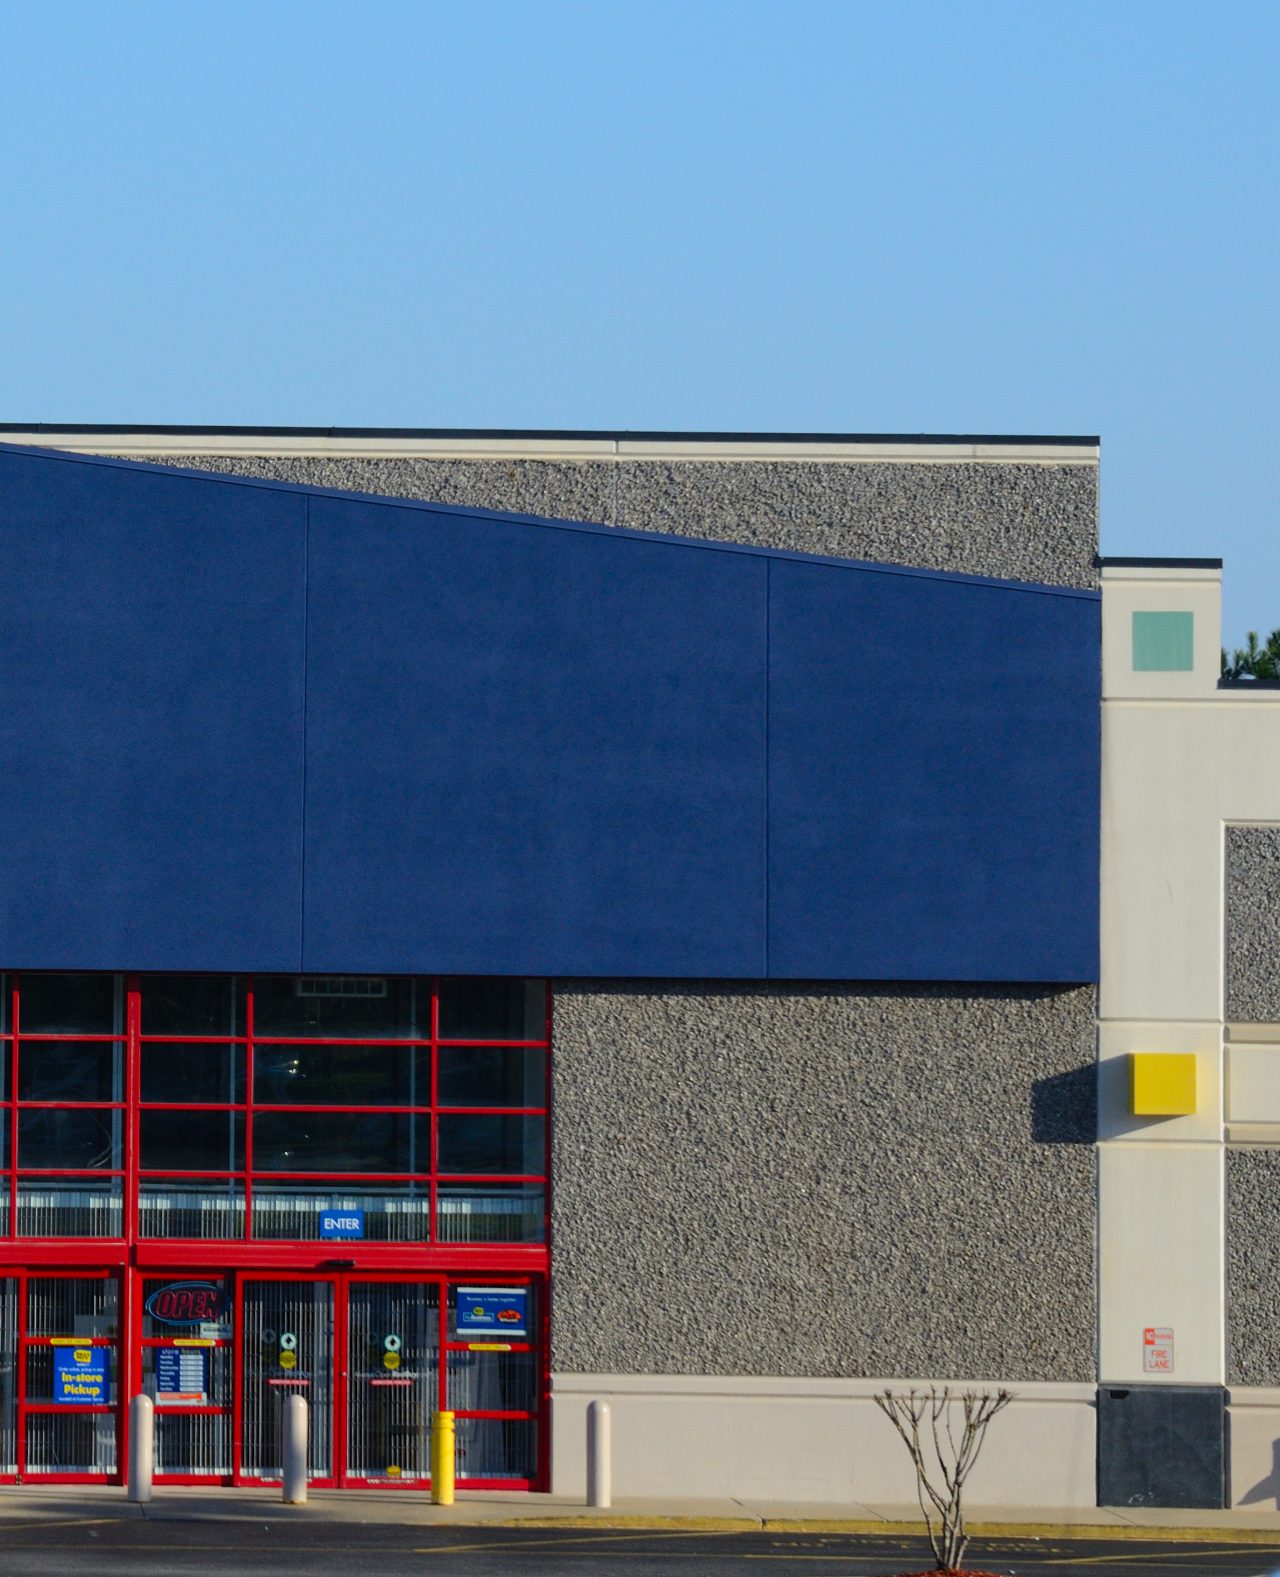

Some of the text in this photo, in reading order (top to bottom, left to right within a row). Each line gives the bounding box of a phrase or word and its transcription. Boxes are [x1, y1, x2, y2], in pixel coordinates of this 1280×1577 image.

[323, 1217, 360, 1230] ENTER
[156, 1290, 219, 1320] OPEN
[1151, 1349, 1168, 1359] FIRE
[1149, 1360, 1169, 1369] LANE
[61, 1371, 103, 1383] In-store
[63, 1383, 101, 1397] Pickup
